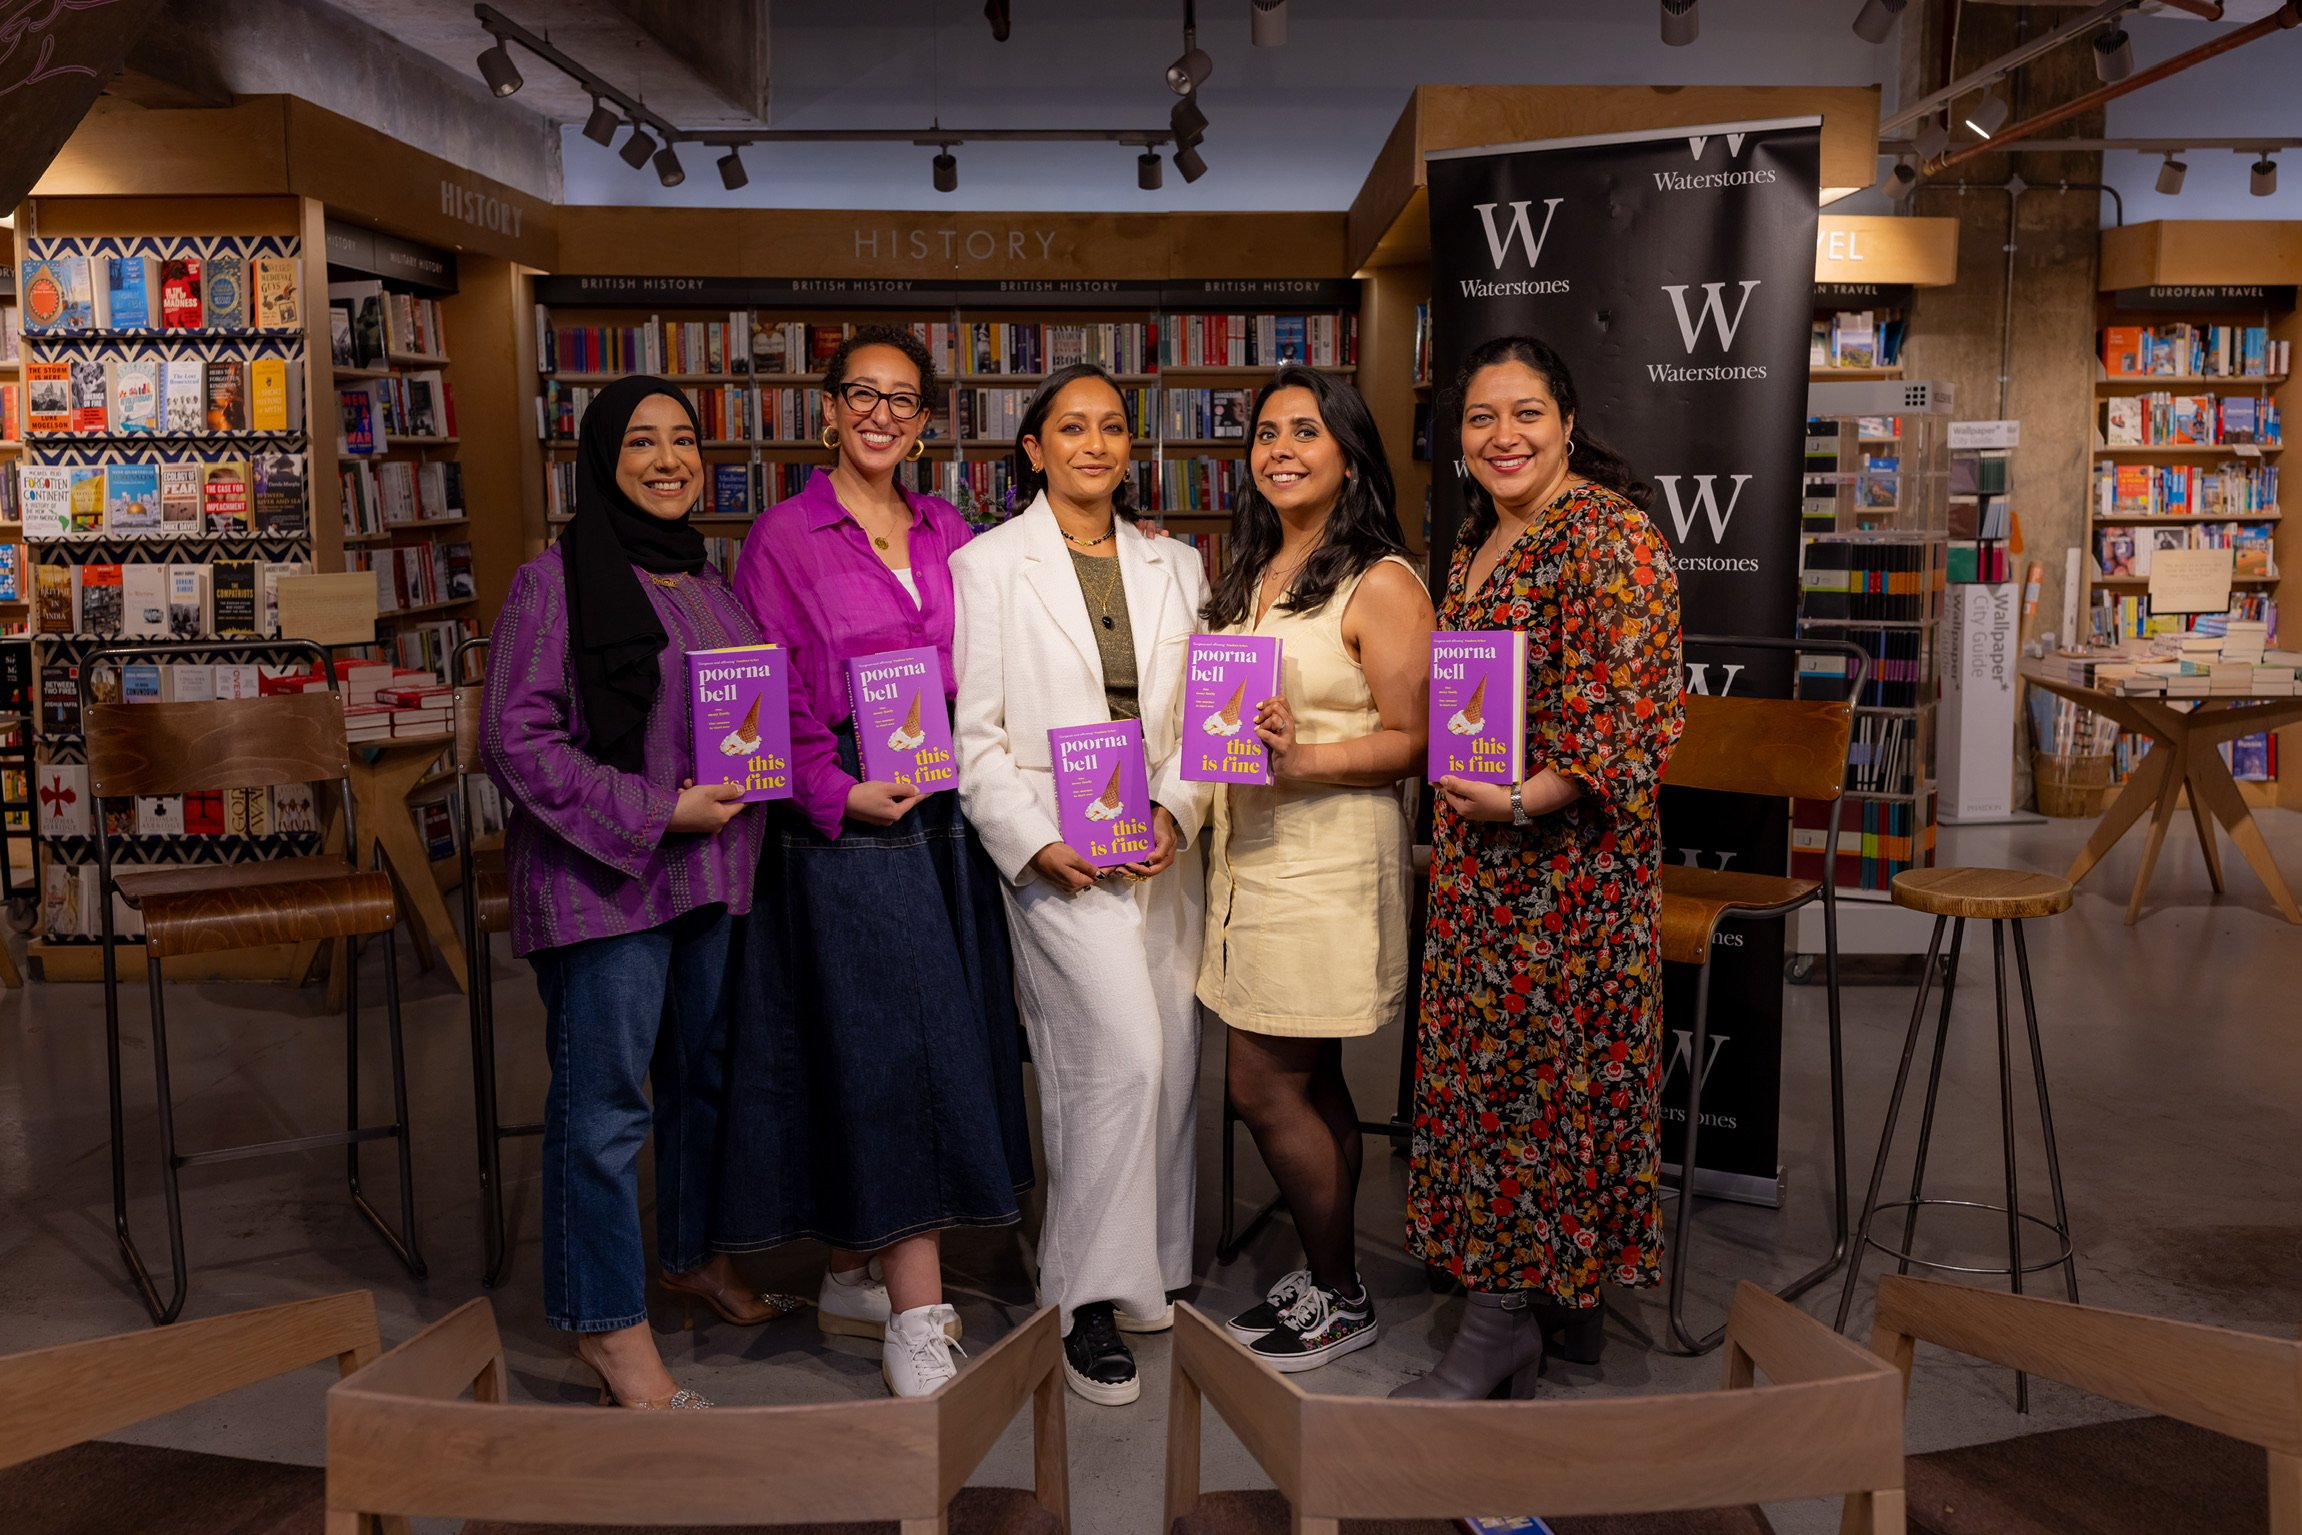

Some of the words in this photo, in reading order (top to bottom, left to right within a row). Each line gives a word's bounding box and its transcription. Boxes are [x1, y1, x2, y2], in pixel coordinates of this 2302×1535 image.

[1654, 167, 1776, 193] Waterstones
[440, 180, 523, 238] HISTORY
[1473, 198, 1564, 270] W
[854, 229, 1057, 261] HISTORY
[418, 256, 443, 273] HISTORY
[261, 281, 281, 293] GUYS
[581, 278, 635, 290] BRITISH
[644, 279, 704, 290] HISTORY
[792, 280, 845, 291] BRITISH
[854, 281, 912, 292] HISTORY
[1001, 281, 1052, 292] BRITISH
[1060, 281, 1118, 292] HISTORY
[1205, 281, 1256, 292] BRITISH
[1264, 281, 1320, 292] HISTORY
[1460, 276, 1570, 299] Waterstones
[1833, 284, 1878, 297] TRAVEL
[2150, 286, 2215, 298] EUROPEAN
[2222, 286, 2264, 298] TRAVEL
[164, 298, 198, 308] MADNESS
[1661, 280, 1761, 354] W
[1646, 361, 1767, 384] Waterstones
[341, 394, 368, 406] MEN
[347, 432, 372, 444] WAR
[24, 478, 68, 489] FORGOTTEN
[163, 472, 186, 482] ECOLOGY
[187, 471, 195, 481] OF
[23, 490, 70, 502] CONTINENT
[163, 483, 197, 494] FEAR
[206, 485, 216, 493] THE
[217, 484, 231, 493] CASE
[233, 484, 244, 492] FOR
[206, 502, 245, 511] IMPEACHMENT
[1654, 474, 1753, 544] W
[163, 523, 179, 531] MIKE
[180, 522, 197, 531] DAVIS
[216, 588, 254, 599] COMPATRIOTS
[44, 612, 66, 620] INDIA
[1971, 595, 1989, 627] City
[1192, 649, 1257, 665] poorna
[1434, 646, 1496, 663] poorna
[1971, 631, 1988, 678] Guide
[698, 664, 771, 686] poorna
[860, 662, 926, 687] poorna
[1191, 665, 1225, 682] bell
[1434, 663, 1464, 680] bell
[44, 687, 58, 695] TWO
[58, 687, 77, 695] FIRES
[699, 683, 737, 703] bell
[862, 682, 898, 703] bell
[1060, 735, 1128, 758] poorna
[1226, 738, 1262, 756] this
[1472, 737, 1506, 755] this
[747, 753, 785, 773] this
[914, 746, 950, 766] this
[1062, 753, 1098, 773] bell
[1202, 754, 1218, 772] is
[1222, 757, 1261, 774] fine
[1449, 754, 1465, 772] is
[1469, 755, 1506, 773] fine
[745, 773, 786, 791] fine
[894, 771, 911, 785] is
[914, 766, 952, 784] fine
[1112, 817, 1147, 836] this
[1090, 841, 1107, 857] is
[1111, 836, 1149, 855] fine
